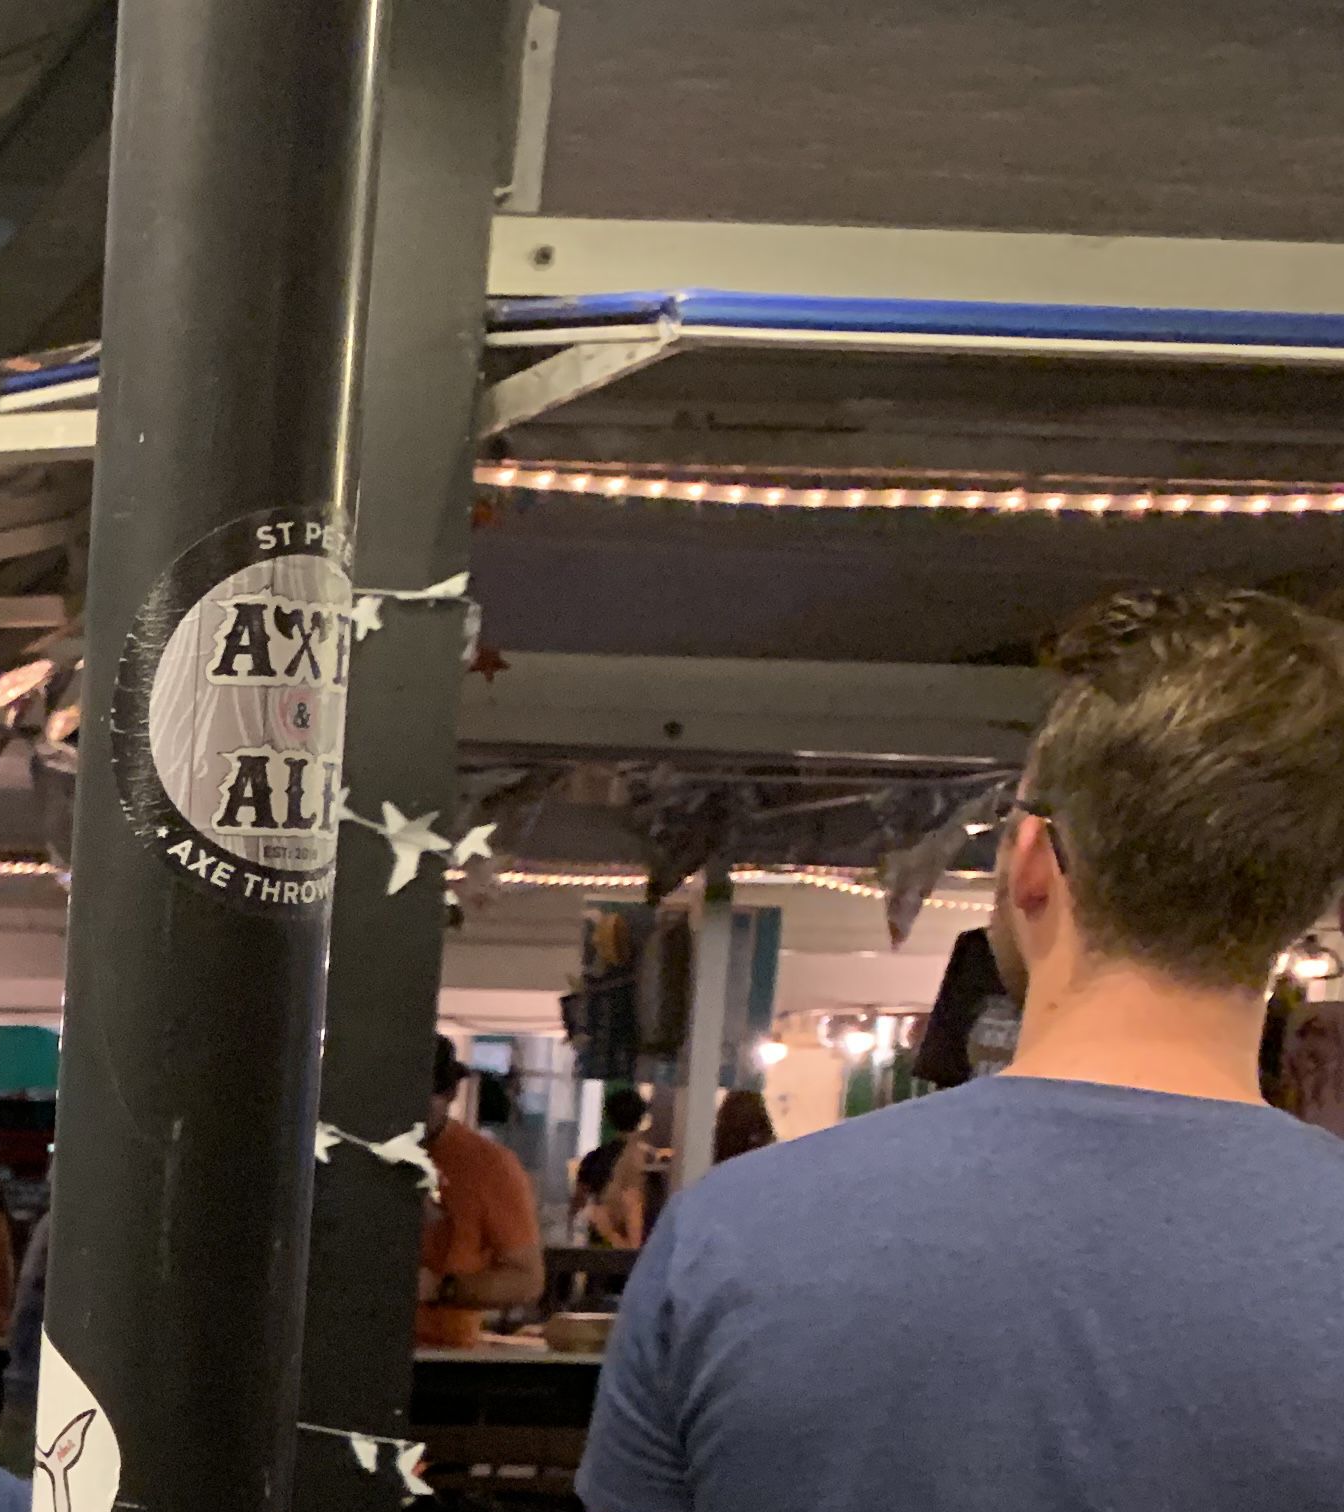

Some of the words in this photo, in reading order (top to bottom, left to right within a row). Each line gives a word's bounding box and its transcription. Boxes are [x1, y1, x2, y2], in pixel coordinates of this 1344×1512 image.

[255, 521, 296, 551] ST
[292, 702, 311, 730] &
[166, 838, 237, 889] AXE
